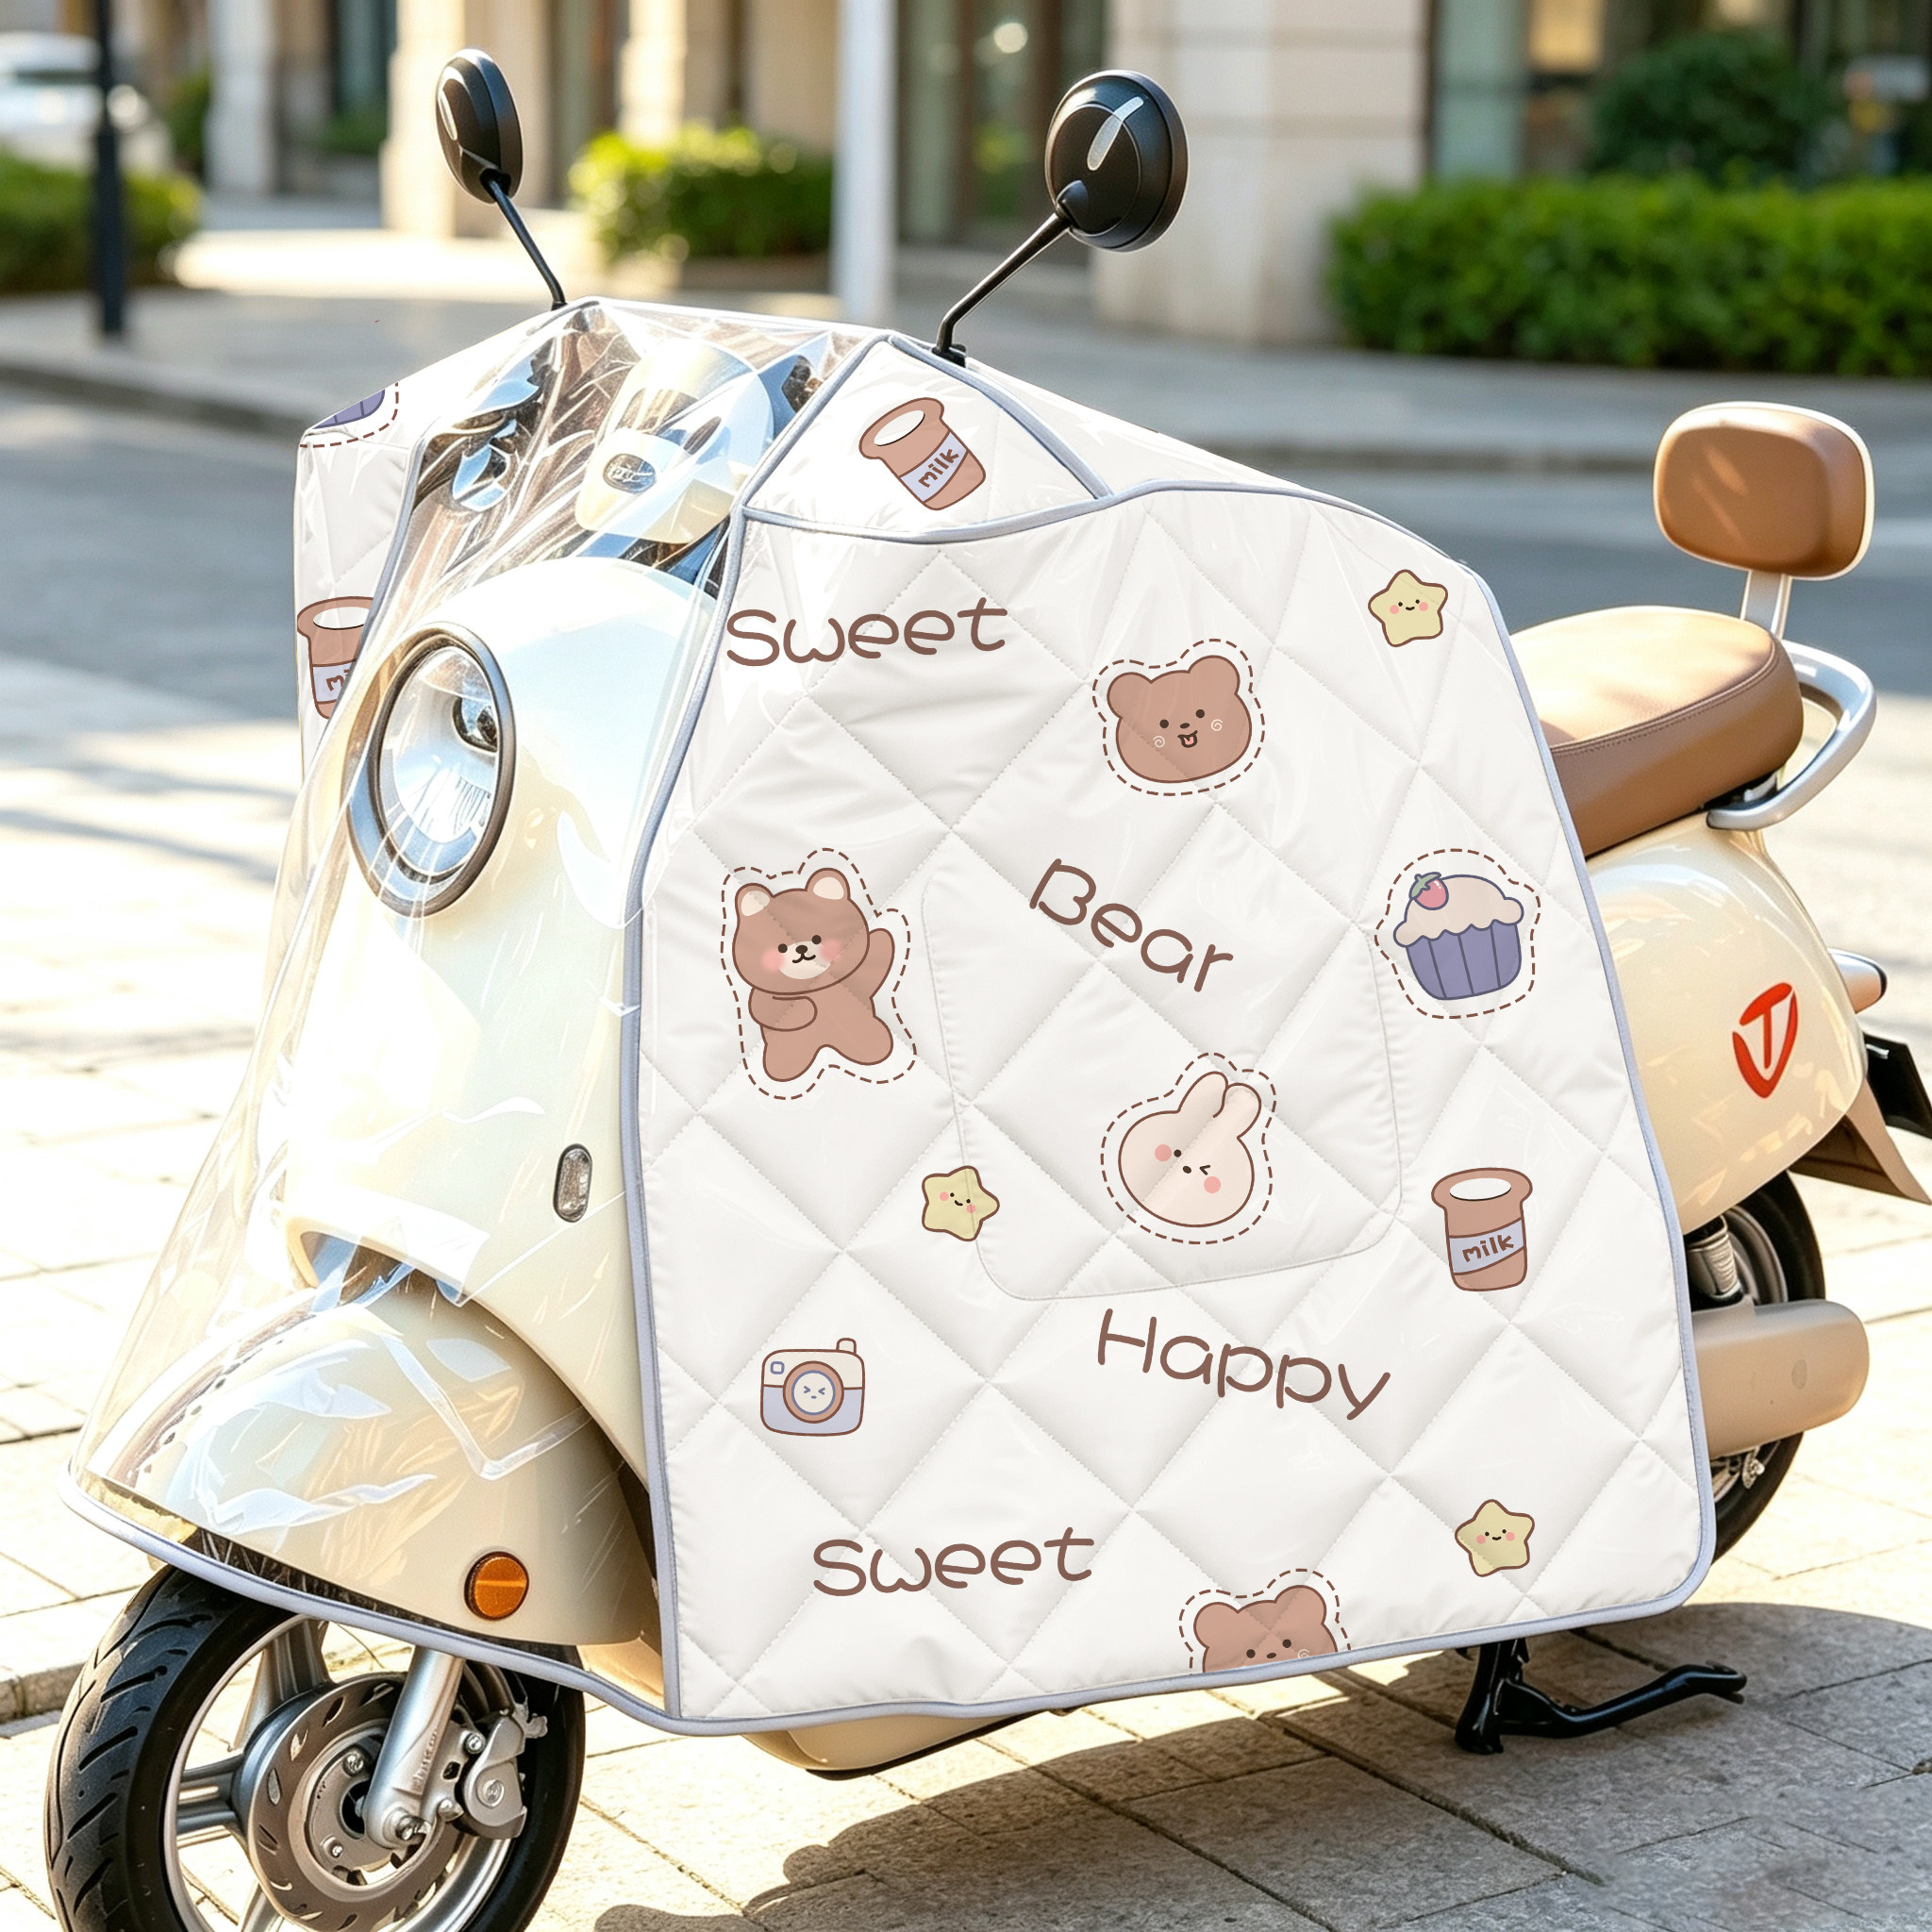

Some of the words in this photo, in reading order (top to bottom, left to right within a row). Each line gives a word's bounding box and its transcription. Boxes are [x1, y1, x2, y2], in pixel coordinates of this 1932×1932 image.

[918, 448, 959, 489] milk
[1029, 858, 1233, 992] Bear
[1461, 1234, 1514, 1263] milk
[1097, 1307, 1391, 1421] Happy
